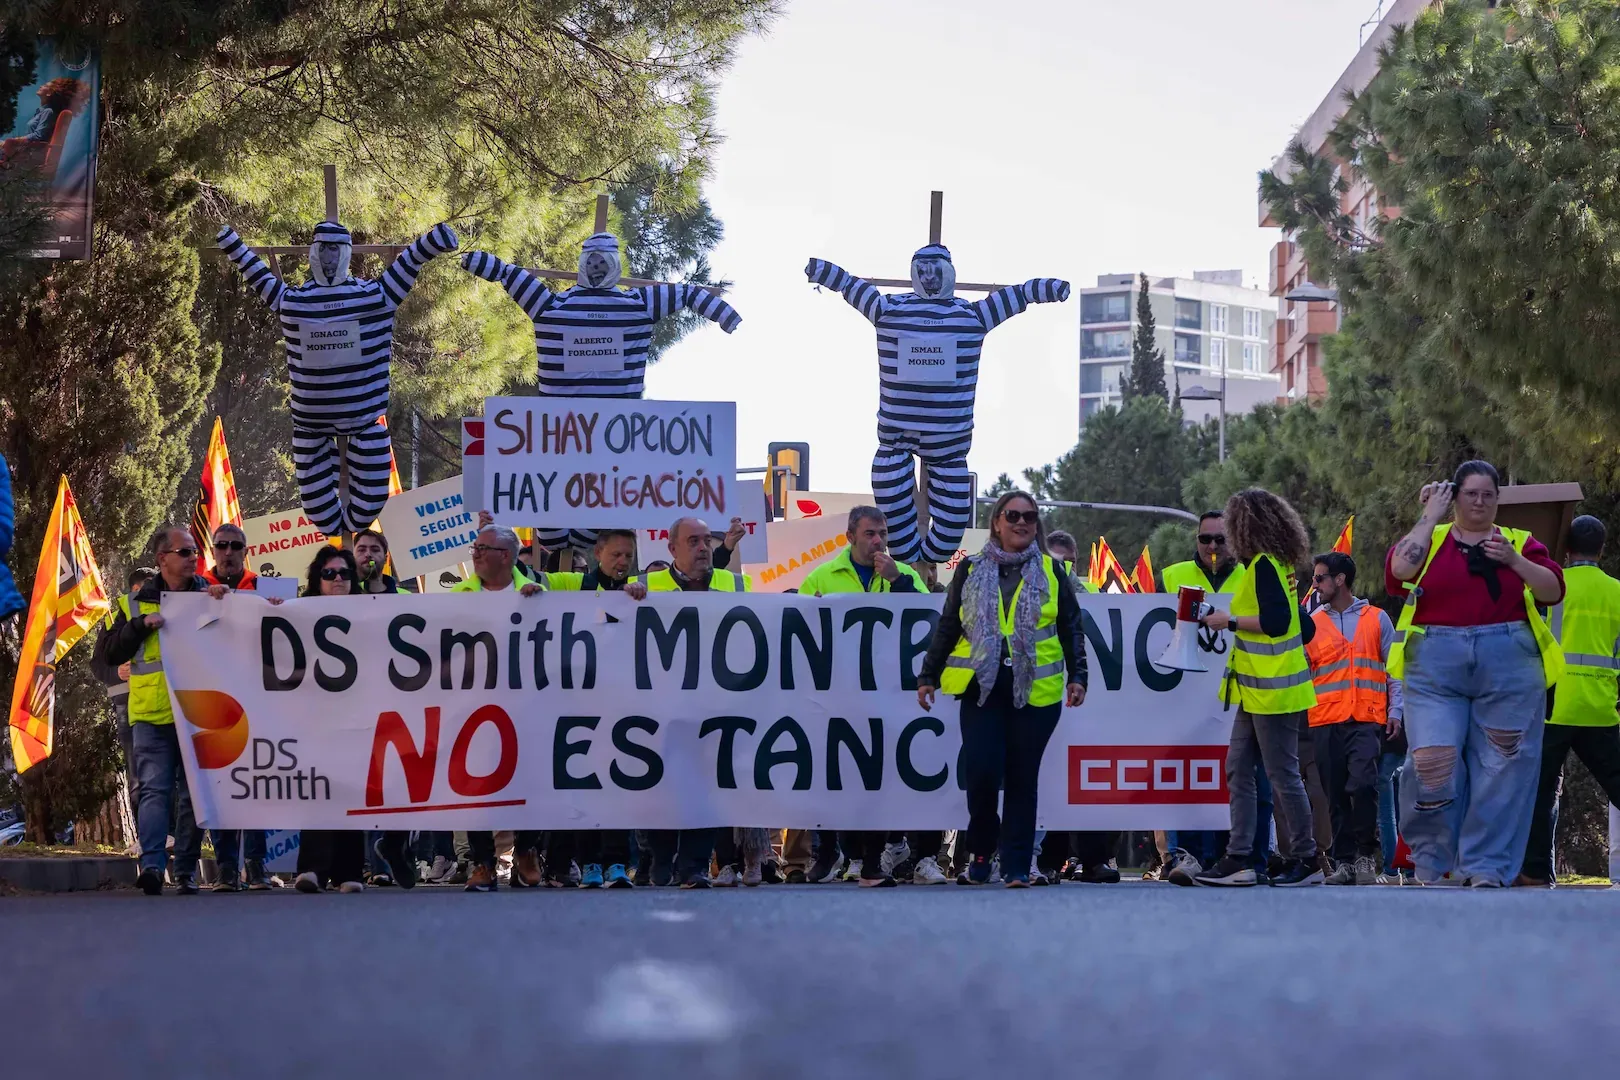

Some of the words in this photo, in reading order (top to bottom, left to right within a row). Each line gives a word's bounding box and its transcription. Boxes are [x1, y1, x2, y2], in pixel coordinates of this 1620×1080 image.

[307, 342, 355, 351] MONTFORT
[310, 330, 348, 339] IGNACIO
[574, 337, 613, 345] ALBERTO
[568, 349, 619, 357] FORCADELL
[911, 346, 944, 354] ISMAEL
[494, 409, 533, 455] SI
[542, 411, 599, 455] HAY
[604, 408, 713, 457] OPCIÓN
[415, 494, 463, 517] VOLEM
[493, 471, 558, 514] HAY
[269, 519, 292, 534] NO
[420, 512, 473, 537] SEGUIR
[248, 531, 328, 557] TANCAME
[409, 528, 481, 560] TREBALLA
[261, 614, 358, 692] DS
[387, 611, 597, 692] Smith
[635, 605, 1184, 692] MONTBNC
[253, 738, 298, 771] DS
[365, 704, 519, 807] NO
[552, 714, 664, 791] ES
[230, 766, 331, 800] Smith
[1080, 759, 1227, 791] CCOO
